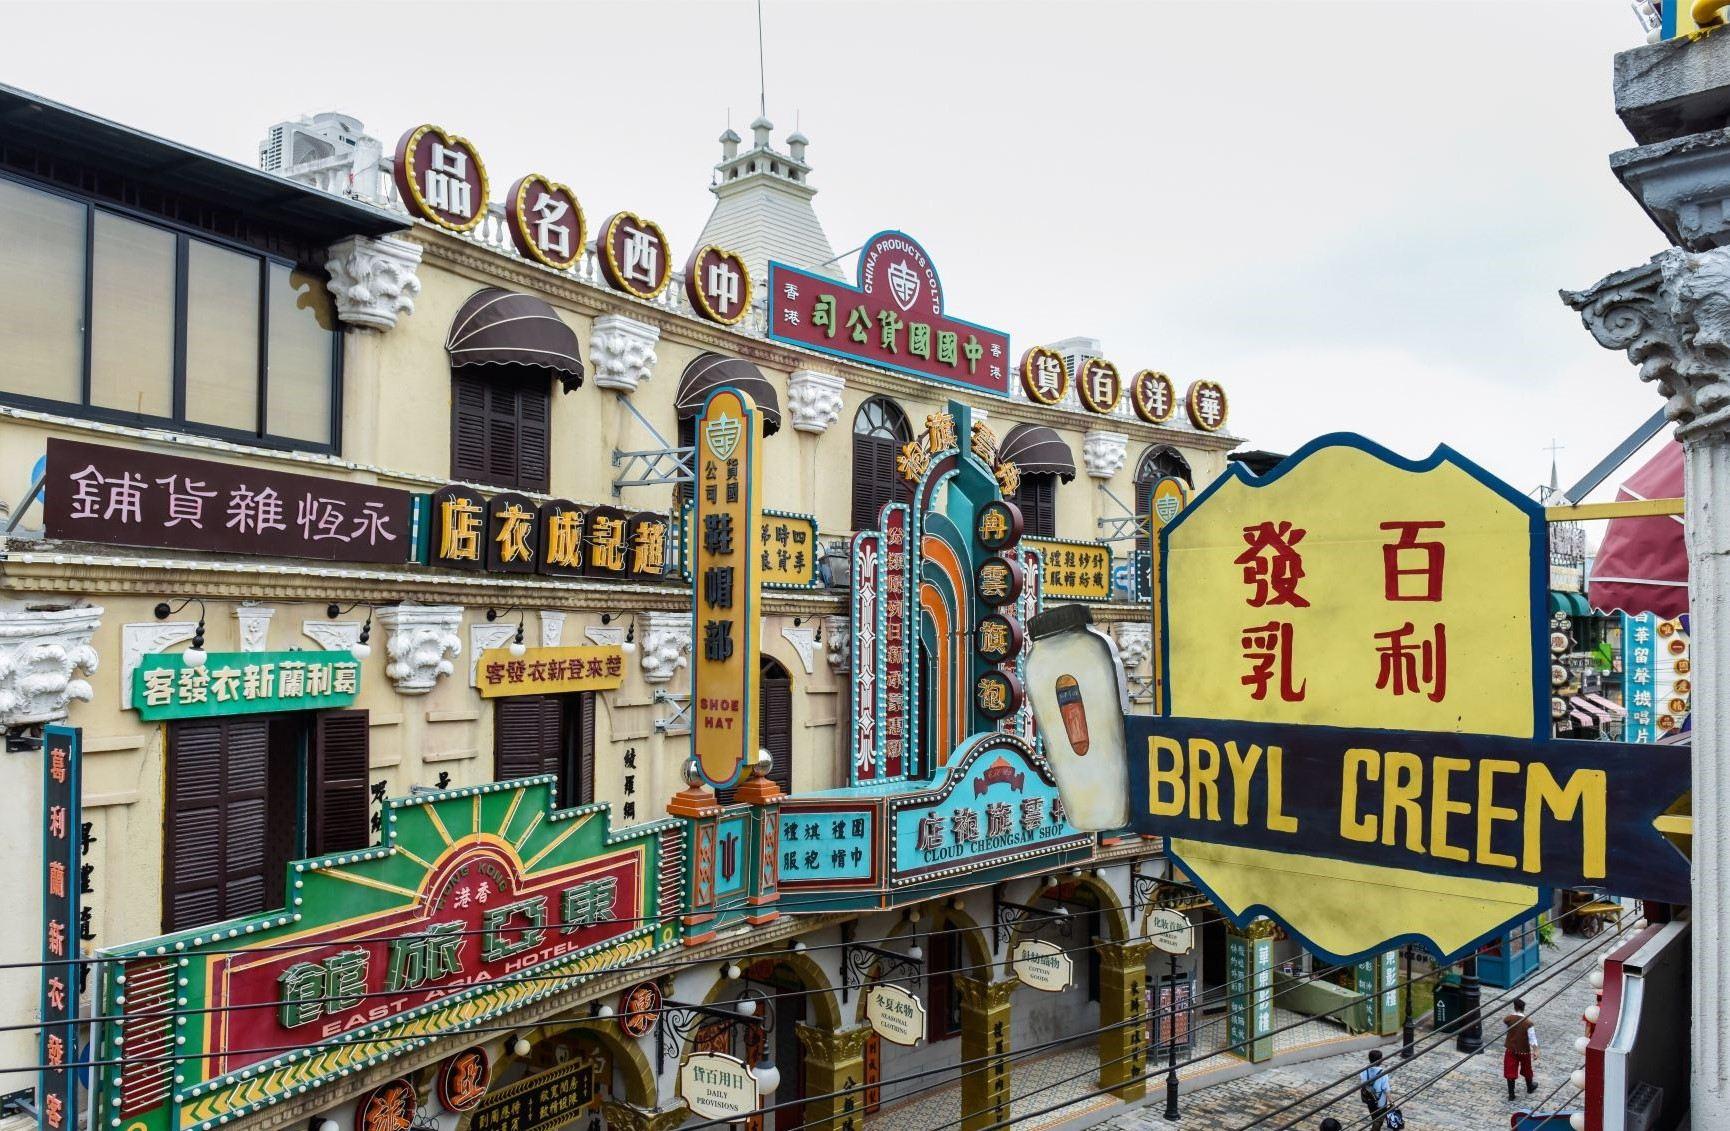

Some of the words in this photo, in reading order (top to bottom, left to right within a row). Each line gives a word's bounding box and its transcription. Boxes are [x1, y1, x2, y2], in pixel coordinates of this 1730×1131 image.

[865, 252, 878, 294] CHINA
[877, 239, 926, 269] PRODUCTS
[784, 283, 800, 326] 香港
[700, 698, 739, 712] SHOE
[705, 717, 733, 729] HAT
[1147, 735, 1299, 833] BRYL
[1340, 748, 1607, 879] CREEM
[924, 844, 964, 863] CLOUD
[970, 830, 1035, 854] CHEONGSAM
[1039, 824, 1064, 838] SHOP
[476, 863, 507, 892] KONG
[322, 998, 411, 1038] EAST
[424, 970, 492, 1001] ASIA
[505, 940, 580, 971] HOTEL
[696, 1097, 739, 1112] PROVISIONS
[706, 1089, 728, 1099] DAILY
